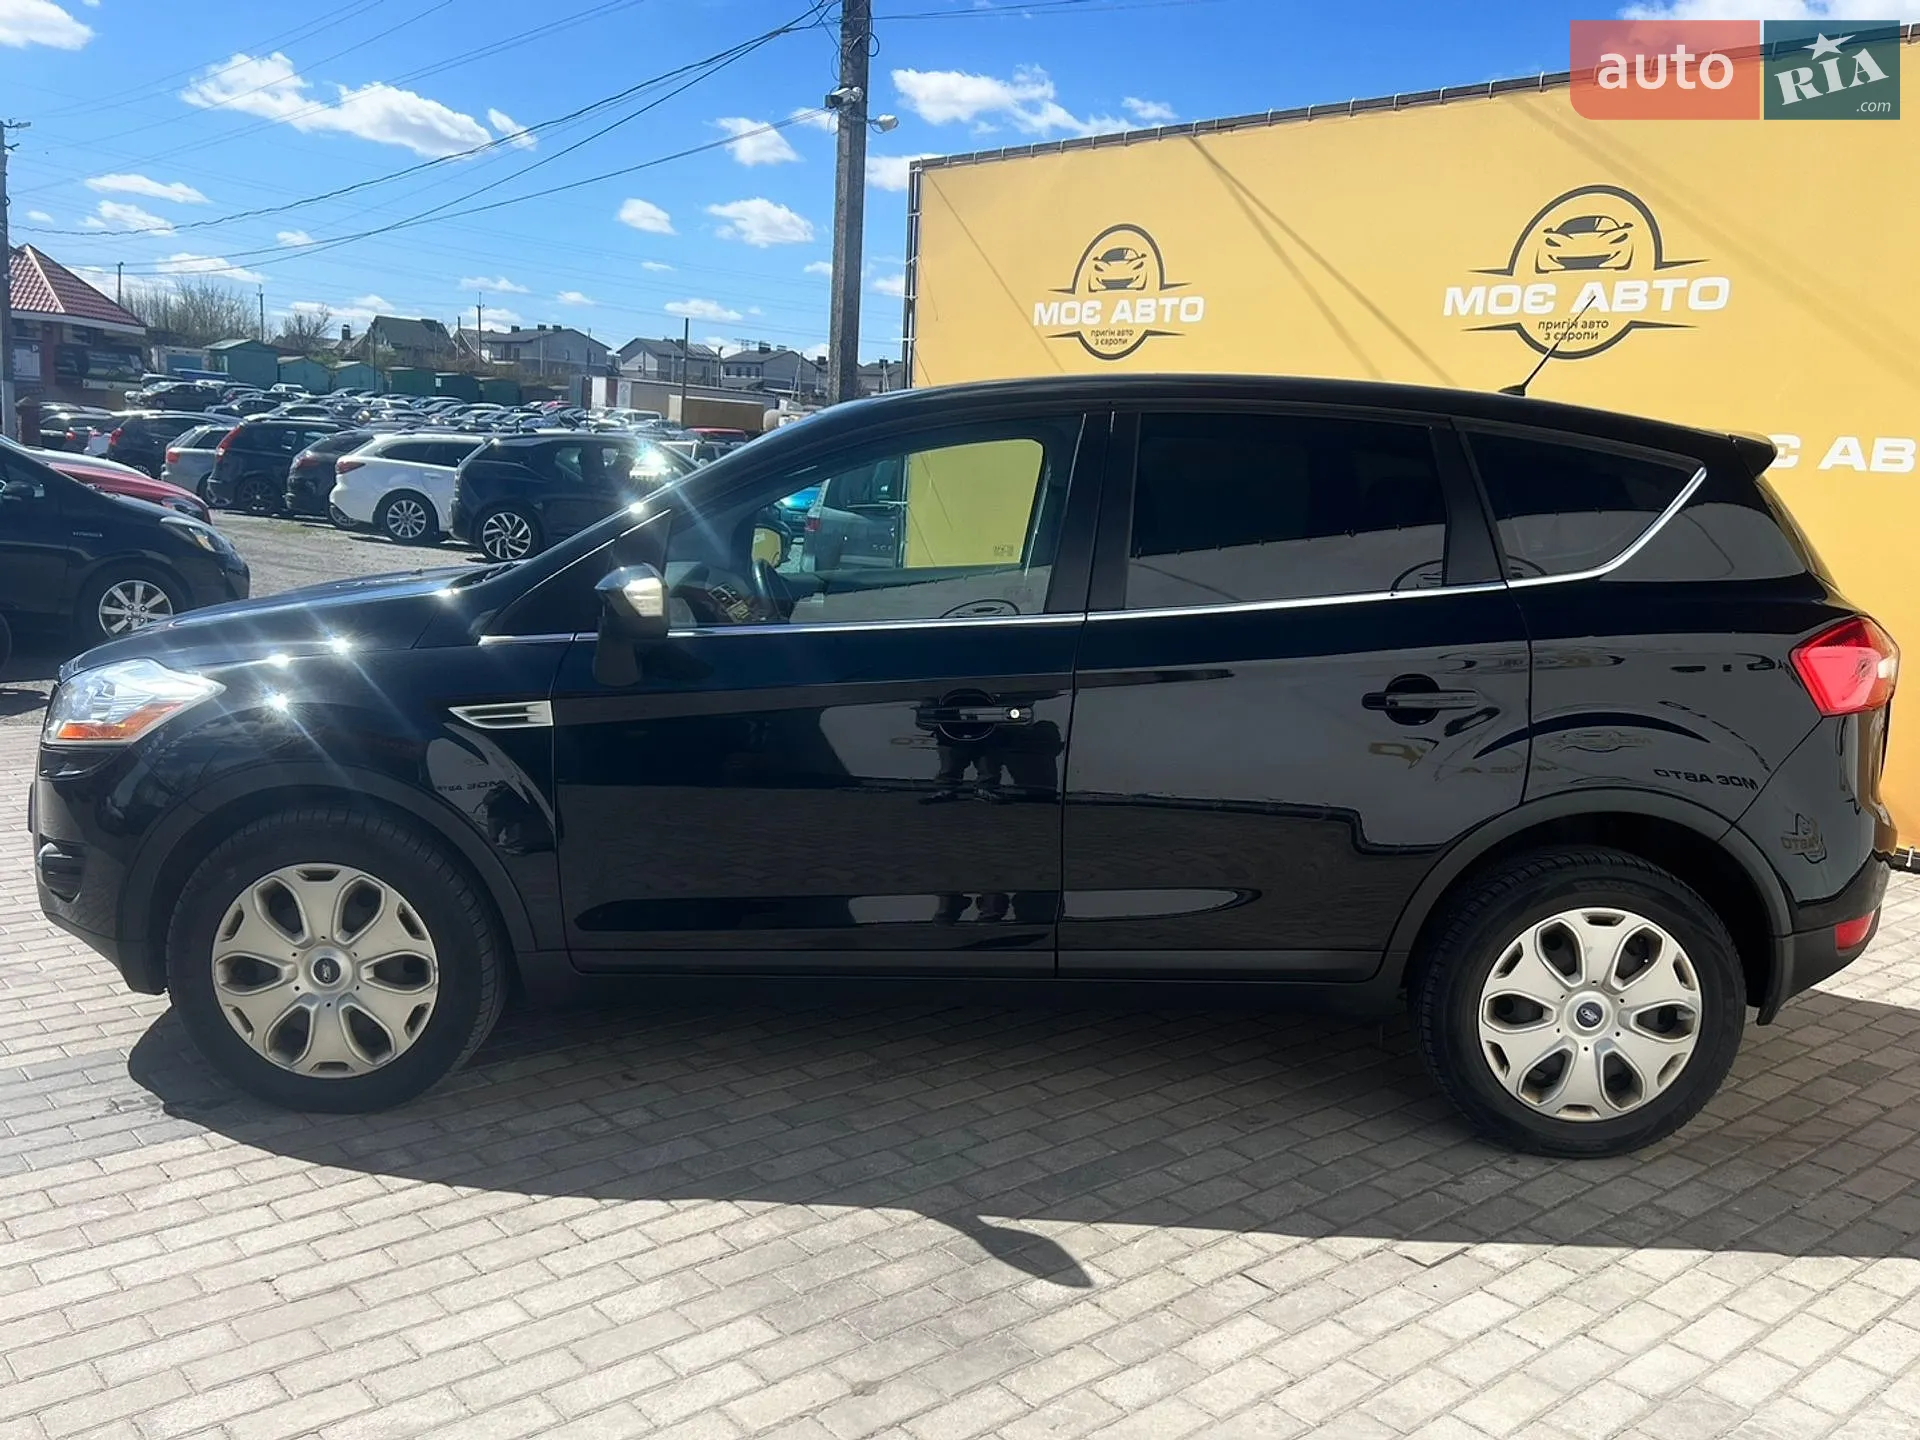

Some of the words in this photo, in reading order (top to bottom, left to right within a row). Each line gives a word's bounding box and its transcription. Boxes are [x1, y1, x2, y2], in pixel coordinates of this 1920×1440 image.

[1034, 302, 1102, 326] МОЄ
[1110, 296, 1205, 324] АВТО
[1443, 283, 1556, 316] МОЄ
[1570, 276, 1730, 313] АВТО
[1581, 319, 1609, 330] авто
[1816, 436, 1917, 473] АВ
